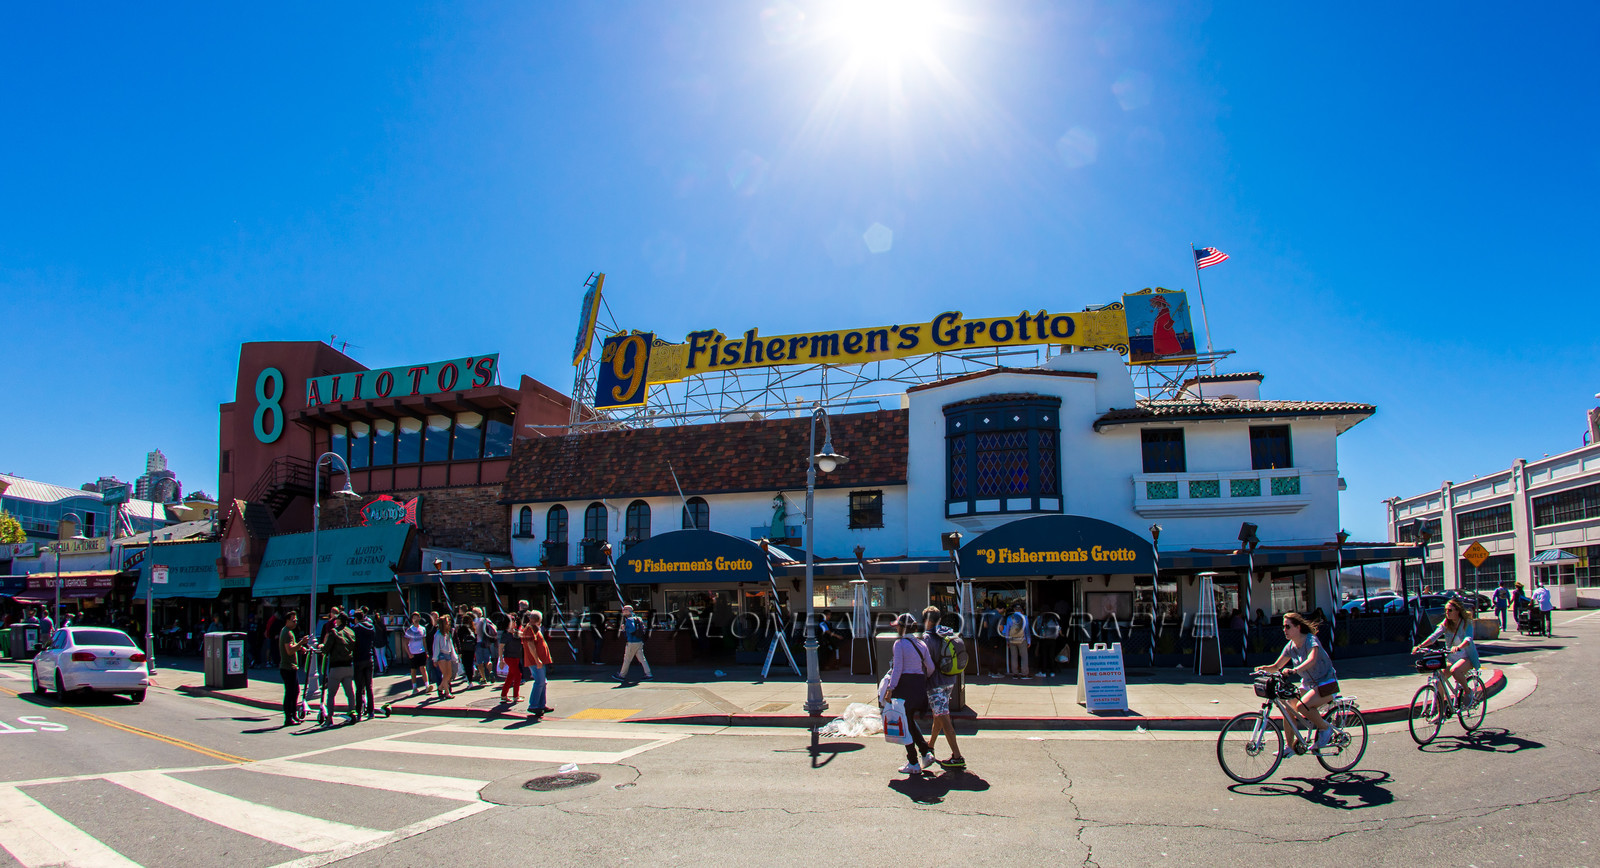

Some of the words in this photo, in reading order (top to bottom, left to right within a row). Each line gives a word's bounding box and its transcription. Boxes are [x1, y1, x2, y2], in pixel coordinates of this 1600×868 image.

[686, 325, 920, 368] Fishermen's
[932, 311, 1075, 346] Grotto
[253, 367, 284, 443] 8
[306, 357, 493, 407] ALIOTO'S
[643, 558, 713, 573] Fishermen's
[715, 556, 753, 571] Grotto
[998, 548, 1088, 563] Fishermen's
[1091, 545, 1136, 562] Grotto
